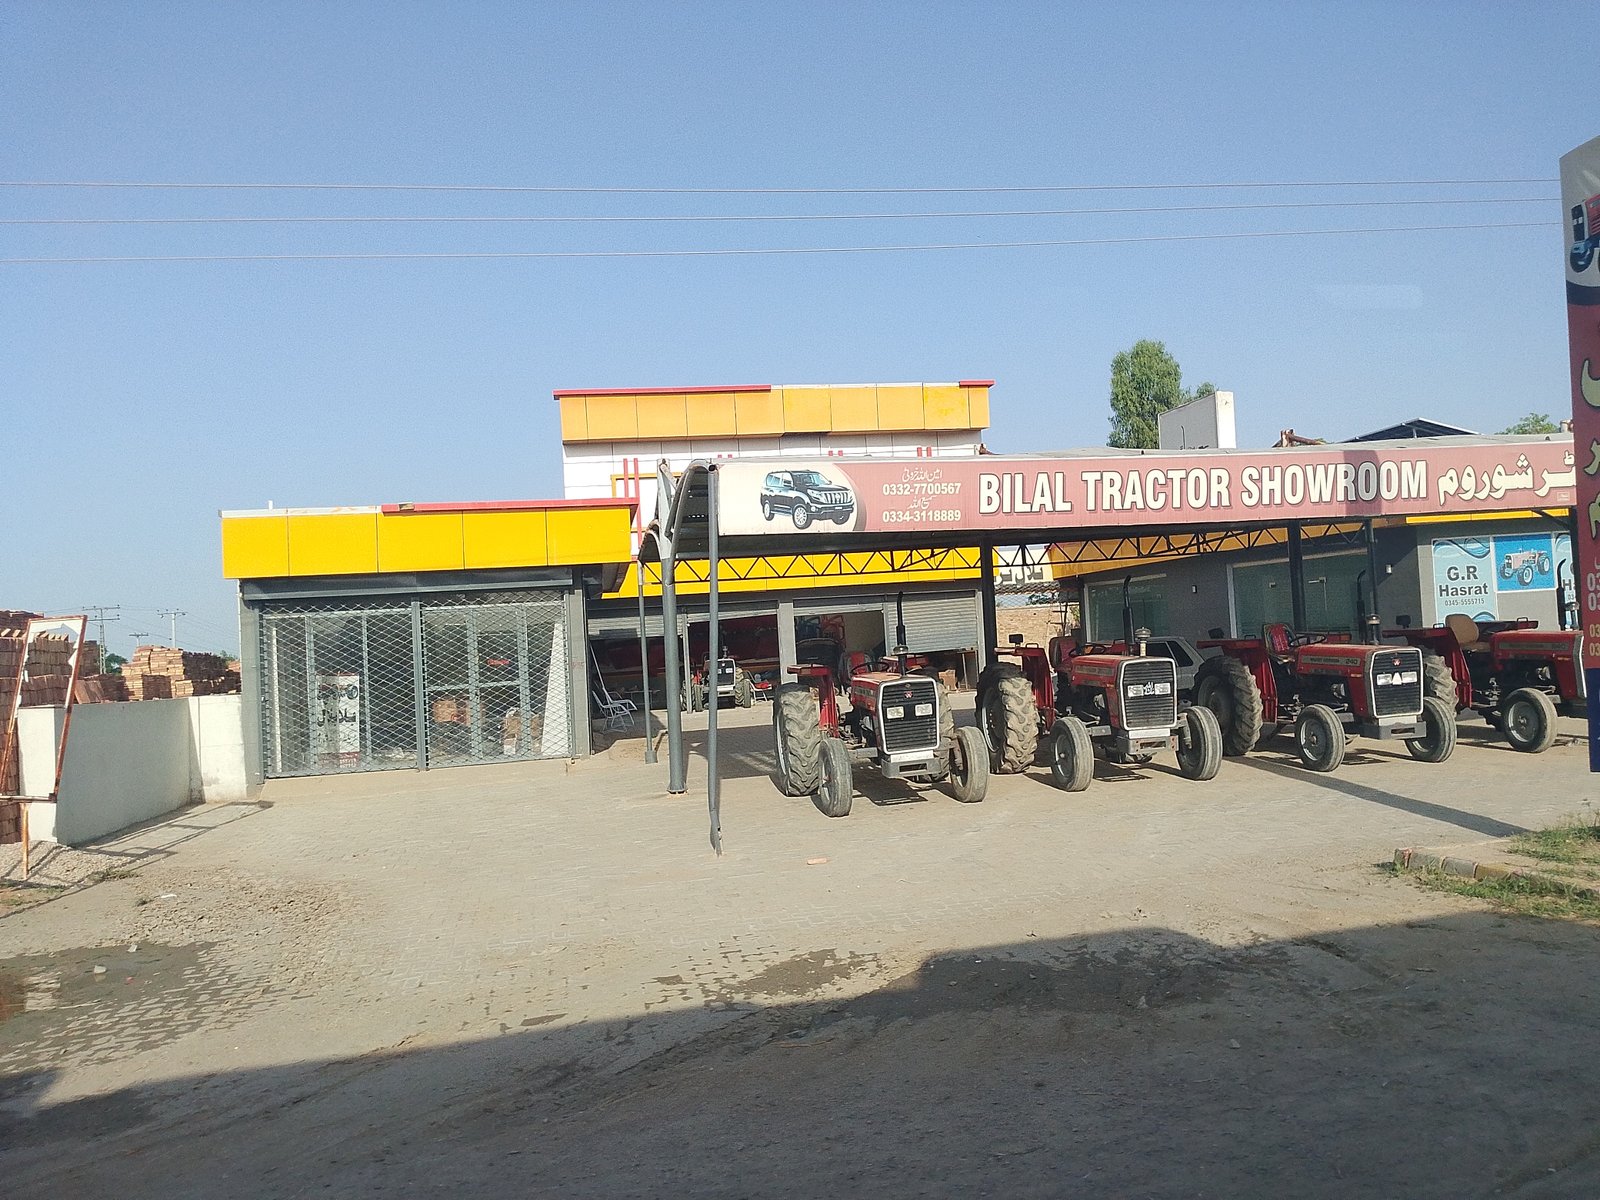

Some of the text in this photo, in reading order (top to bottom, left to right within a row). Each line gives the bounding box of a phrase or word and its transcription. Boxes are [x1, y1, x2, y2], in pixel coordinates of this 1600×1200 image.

[1437, 453, 1534, 506] شوروم
[882, 482, 962, 496] 0332-7700567
[979, 460, 1428, 515] BILAL TRACTOR SHOWROOM
[882, 509, 962, 523] 0334-3118889
[1446, 565, 1479, 581] G.R
[1438, 582, 1489, 597] Hasrat
